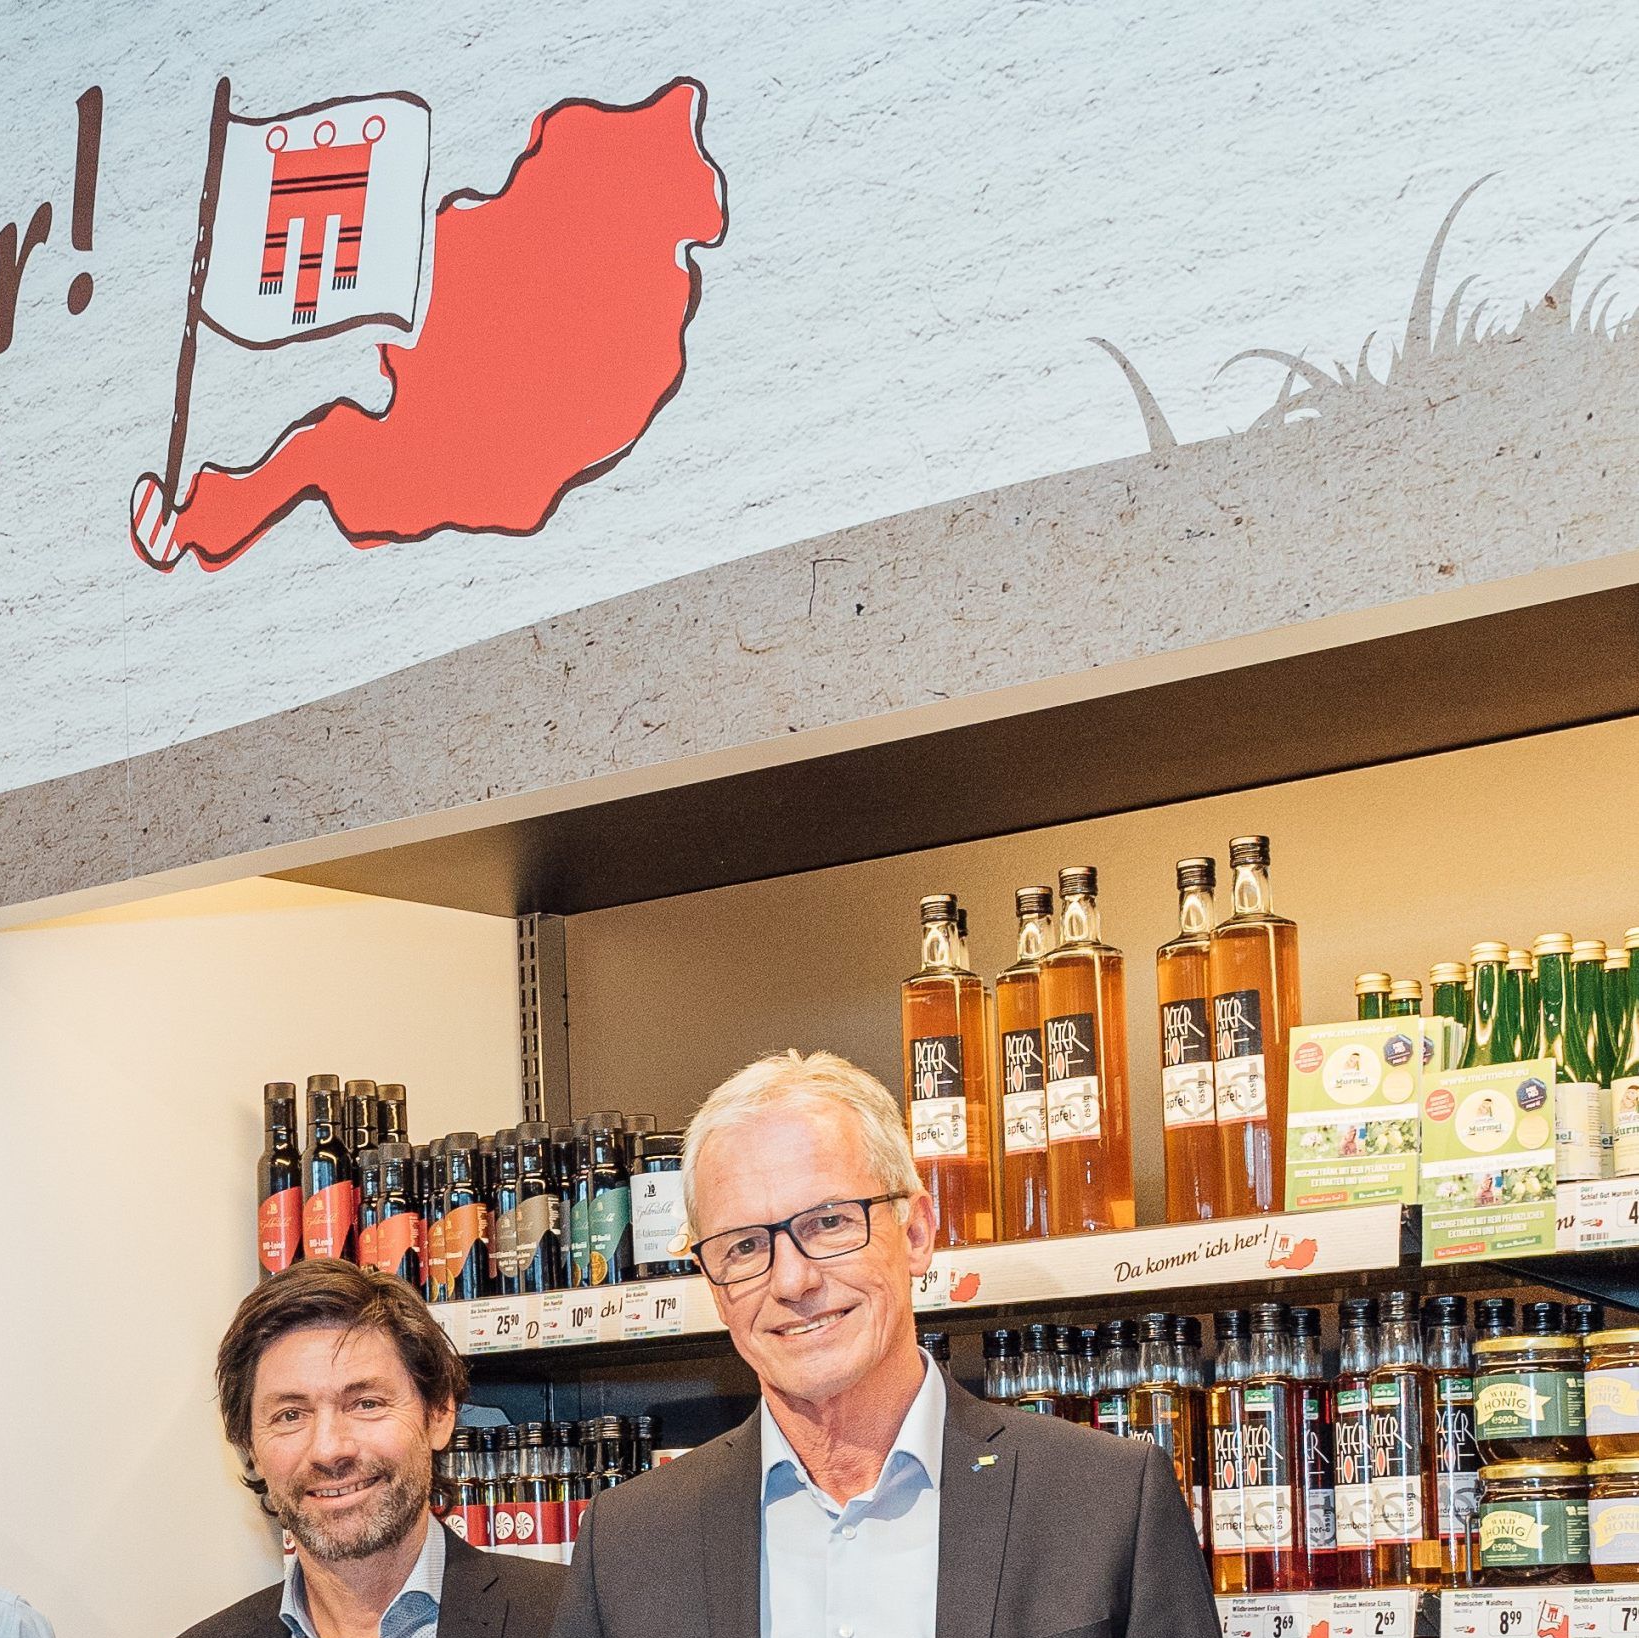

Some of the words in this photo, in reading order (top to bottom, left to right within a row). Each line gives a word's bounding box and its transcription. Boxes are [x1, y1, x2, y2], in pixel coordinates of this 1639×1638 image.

[1163, 1005, 1204, 1037] PETER
[1216, 997, 1255, 1030] PETER
[1048, 1021, 1090, 1051] PETER
[1216, 1028, 1249, 1058] HOF
[915, 1042, 958, 1073] PETER
[1005, 1035, 1043, 1065] PETER
[1164, 1036, 1199, 1065] HOF
[1005, 1064, 1041, 1092] HOF
[1048, 1051, 1083, 1080] HOF
[915, 1071, 952, 1100] HOF
[1218, 1089, 1242, 1106] apfel-
[1051, 1108, 1075, 1124] apfel-
[1166, 1096, 1190, 1110] apfel-
[916, 1124, 944, 1141] apfel-
[1008, 1122, 1032, 1136] apfel-
[1114, 1261, 1141, 1284] Da
[1146, 1243, 1202, 1274] komm'
[1204, 1236, 1231, 1260] ich
[1233, 1225, 1269, 1256] her!
[600, 1301, 617, 1318] ch
[1484, 1397, 1527, 1411] HONIG
[1215, 1428, 1242, 1460] PETE
[1486, 1525, 1525, 1538] HONIG
[1273, 1615, 1293, 1638] 369
[1375, 1611, 1395, 1634] 269
[1500, 1610, 1521, 1634] 899
[1622, 1607, 1639, 1631] 79
